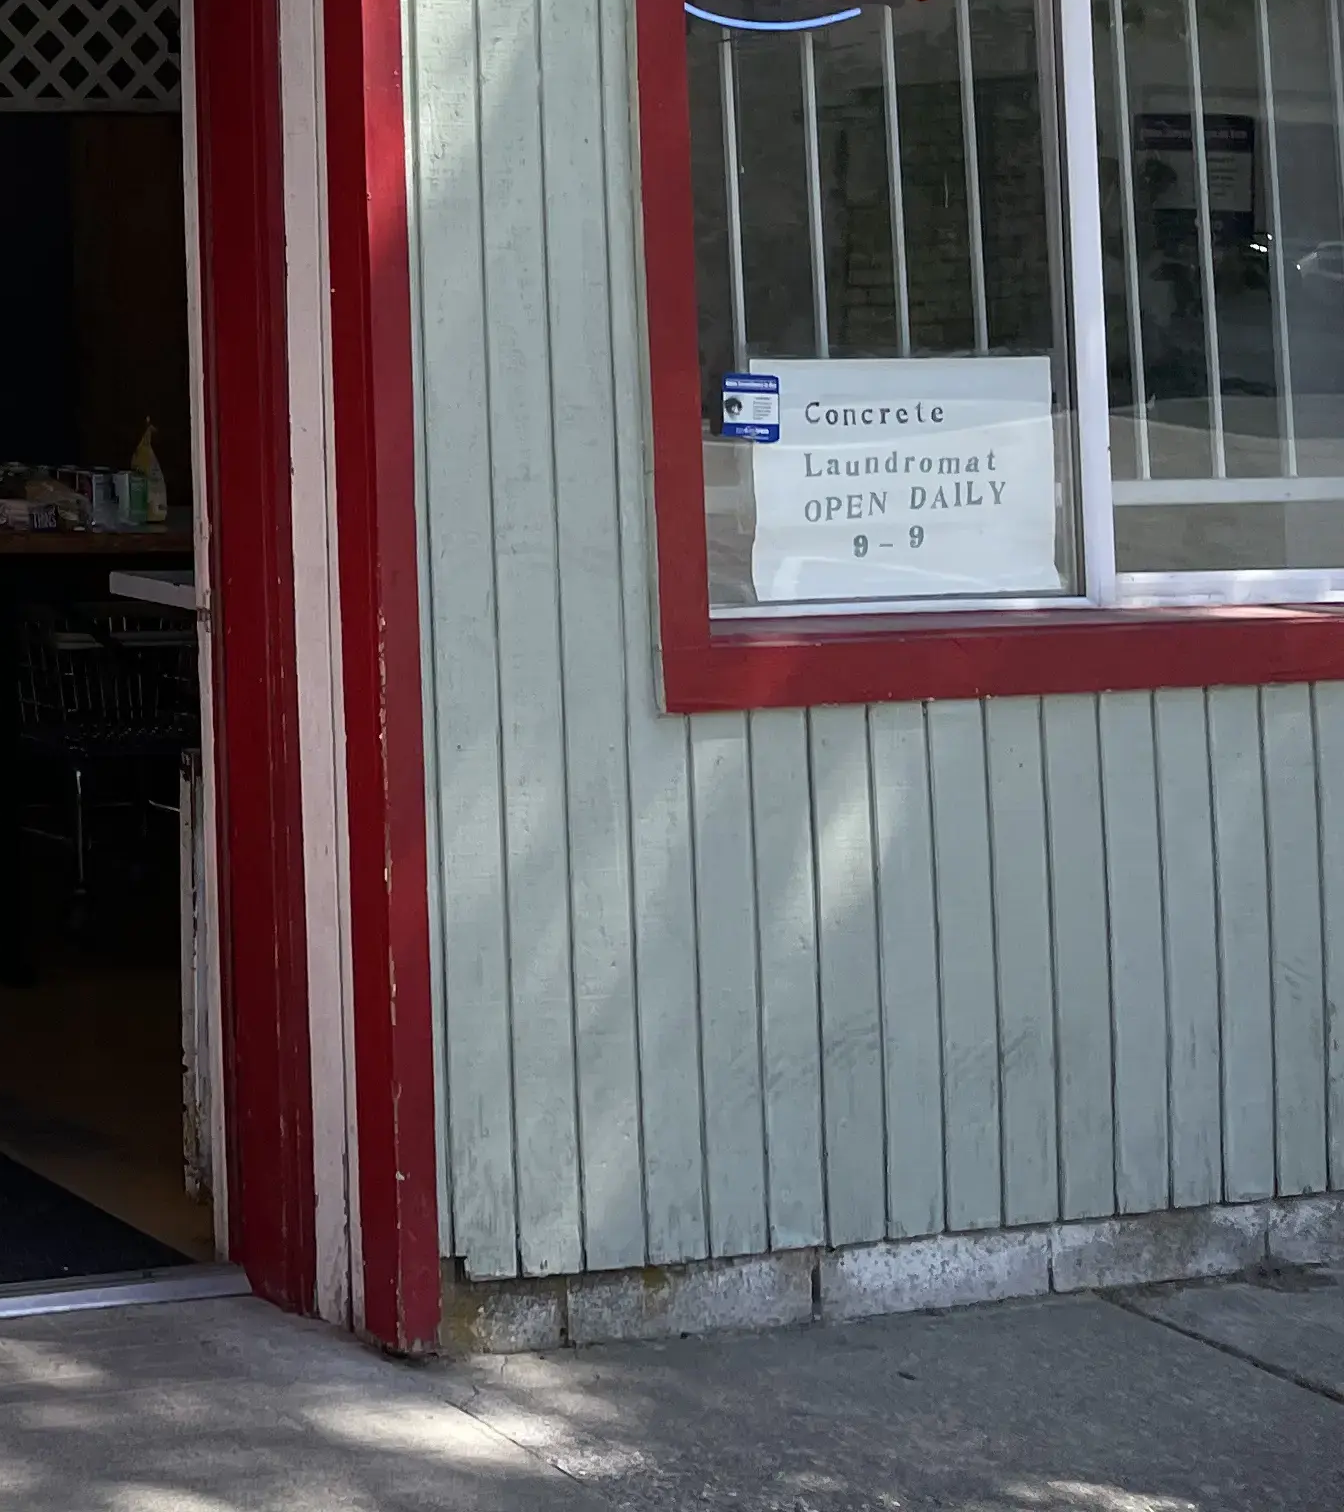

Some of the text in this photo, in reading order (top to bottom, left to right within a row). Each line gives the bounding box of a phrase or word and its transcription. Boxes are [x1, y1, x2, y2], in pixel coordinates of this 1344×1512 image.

[803, 401, 945, 425] Concrete
[803, 448, 997, 478] Laundromat
[804, 480, 1006, 523] OPEN DAILY
